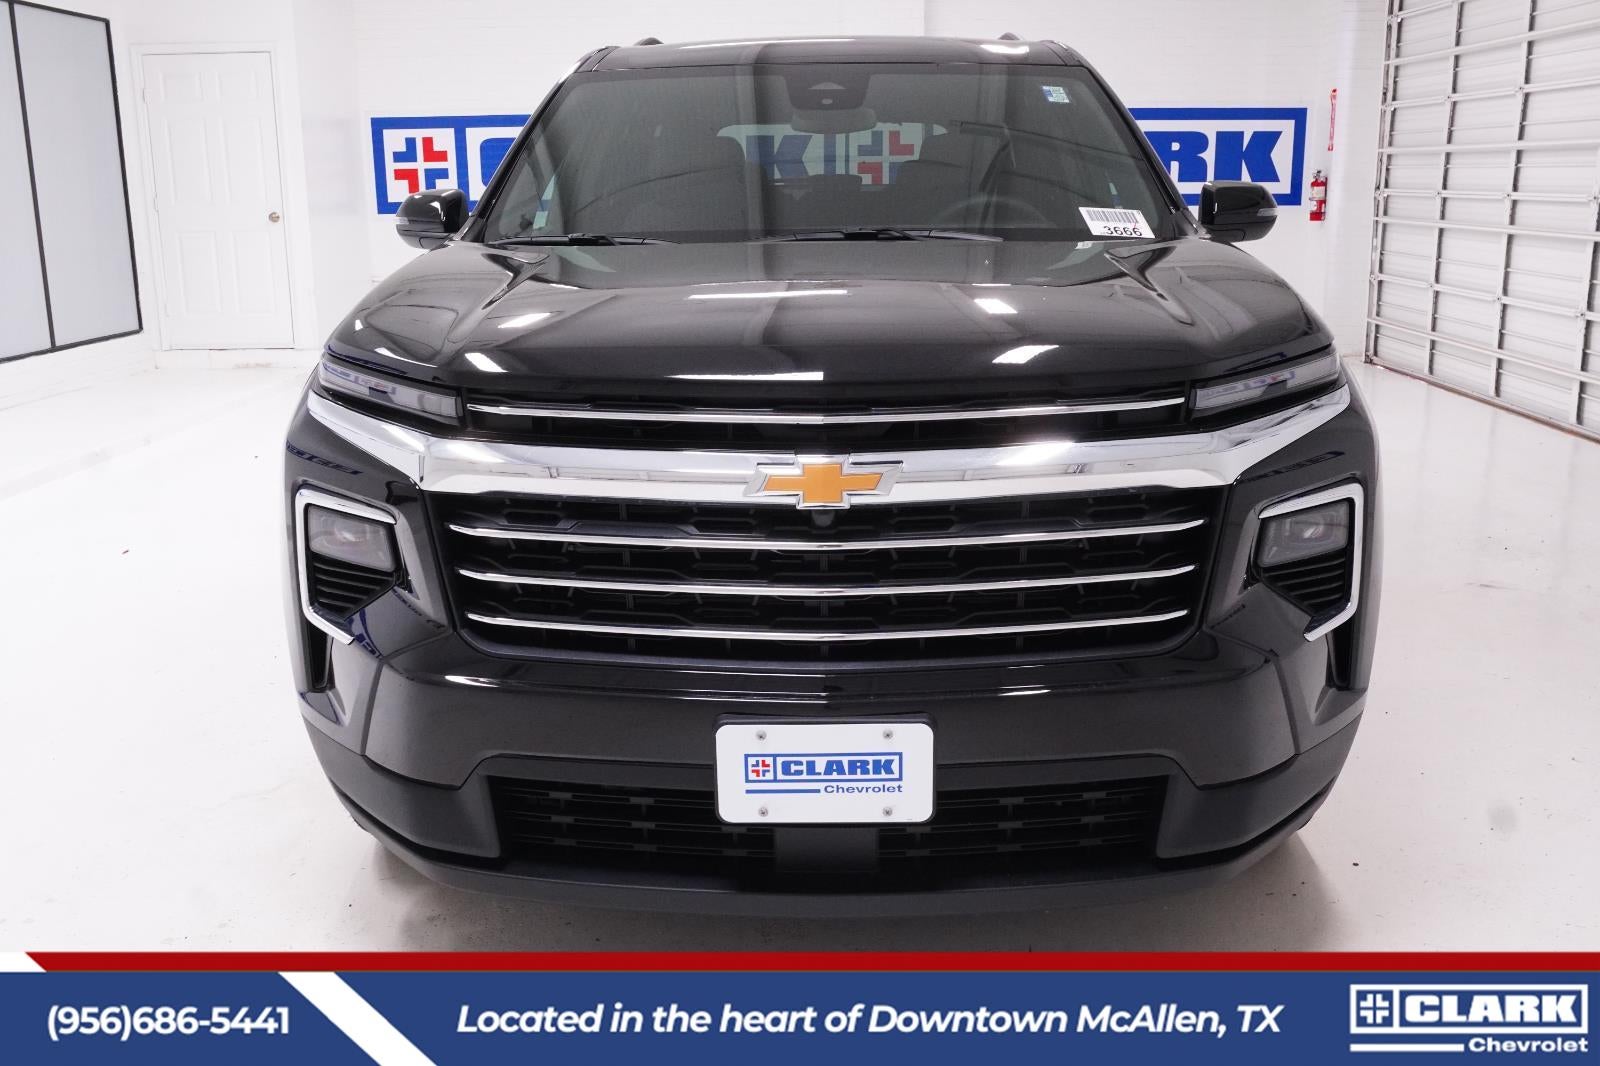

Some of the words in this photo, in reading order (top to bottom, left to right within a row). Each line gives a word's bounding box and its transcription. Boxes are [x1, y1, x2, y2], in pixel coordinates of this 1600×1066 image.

[1103, 225, 1142, 236] 3666
[781, 759, 895, 776] CLARK
[823, 783, 903, 794] Chevrolet
